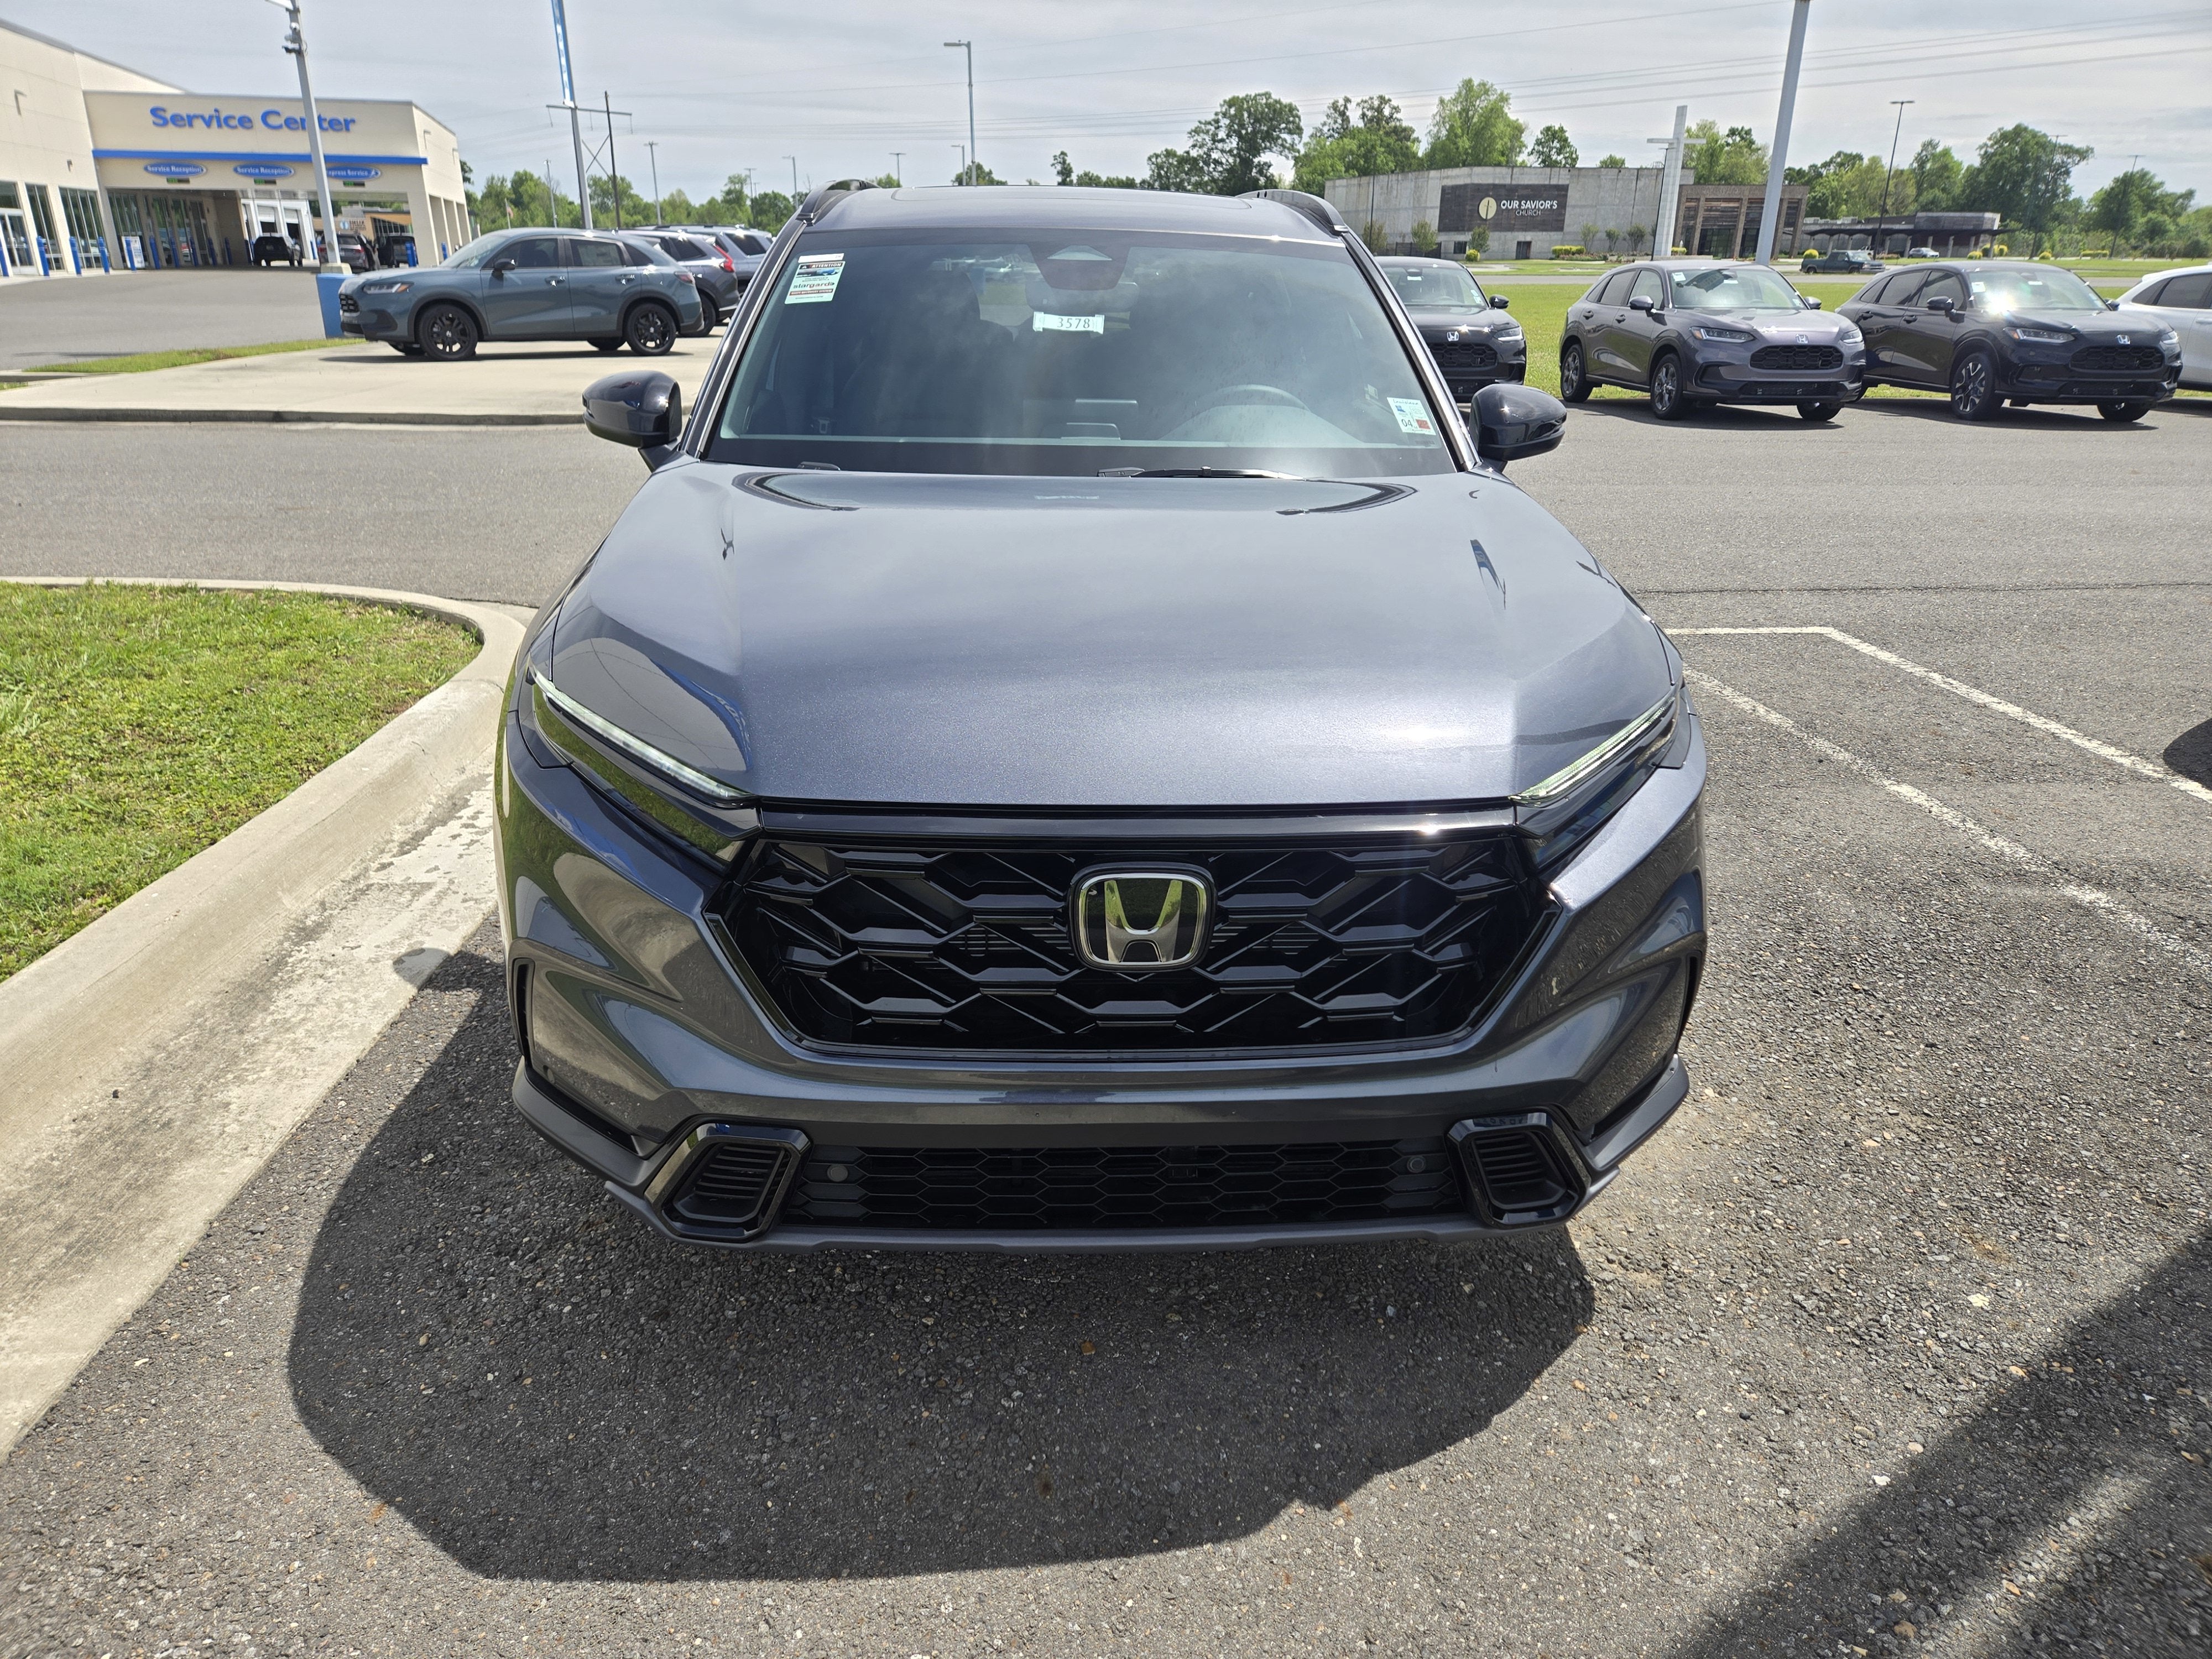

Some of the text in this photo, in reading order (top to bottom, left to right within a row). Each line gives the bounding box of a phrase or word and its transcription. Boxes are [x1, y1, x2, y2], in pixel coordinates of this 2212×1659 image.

[149, 106, 253, 129] Service
[1500, 200, 1558, 210] OUR SAVIOR'S
[1057, 317, 1090, 329] 3578
[1401, 419, 1413, 427] 04
